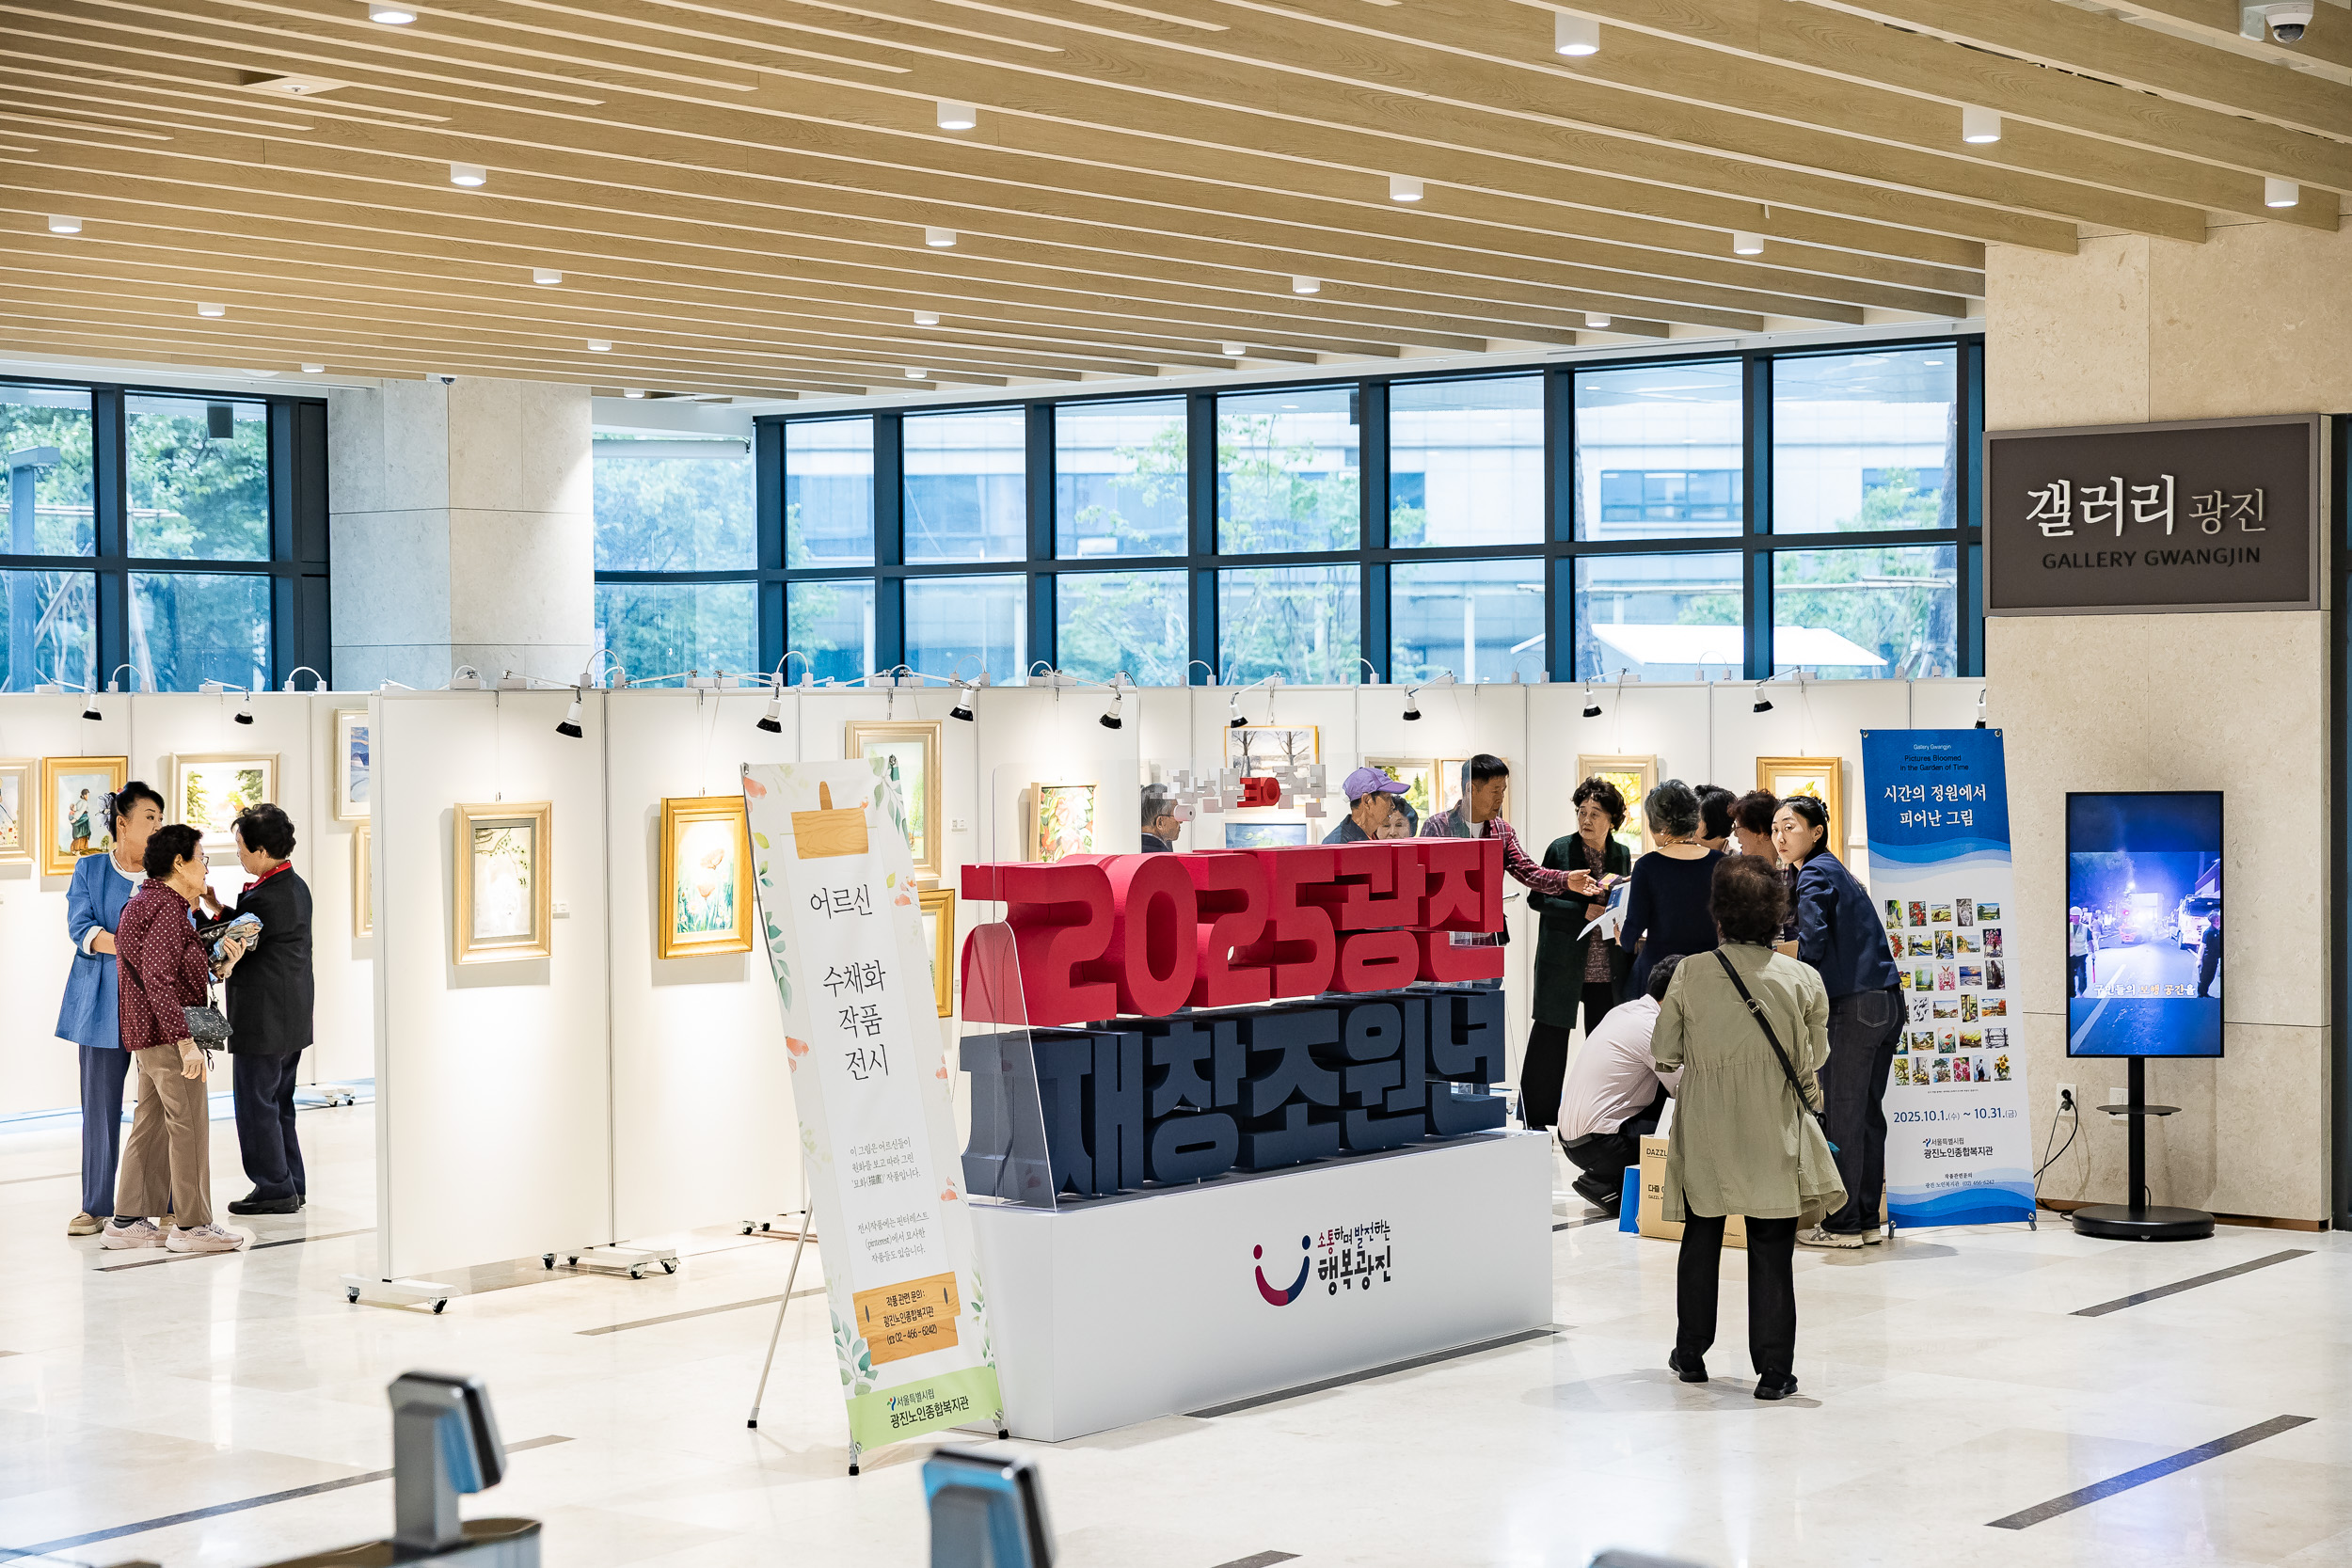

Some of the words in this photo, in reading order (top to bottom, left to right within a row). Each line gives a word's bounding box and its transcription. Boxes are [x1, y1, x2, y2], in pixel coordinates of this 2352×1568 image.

[2026, 473, 2174, 537] 갤러리
[2188, 487, 2266, 535] 광진
[2042, 550, 2137, 570] GALLERY
[2144, 546, 2261, 568] GWANGJIN
[1883, 784, 1926, 803] 시간의
[1931, 784, 1987, 802] 정원에서
[1899, 809, 1942, 828] 피어난
[1946, 808, 1974, 828] 그림
[809, 883, 873, 921] 어르신
[822, 959, 886, 999] 수채화
[2138, 984, 2160, 996] 보행
[2164, 984, 2197, 996] 공간을
[839, 1004, 883, 1039] 작품
[844, 1043, 890, 1081] 전시
[850, 1146, 857, 1156] 이
[858, 1143, 878, 1155] 그림은
[879, 1136, 911, 1151] 어르신들이
[1931, 1137, 1964, 1146] 서울특별시립
[873, 1158, 886, 1169] 보고
[886, 1154, 900, 1166] 따라
[901, 1151, 914, 1164] 그린
[1924, 1146, 1994, 1160] 광진노인종합복지관
[896, 1212, 930, 1226] 핀터레스트
[906, 1227, 926, 1241] 묘사한
[1317, 1226, 1353, 1255] 소통하며
[1354, 1219, 1391, 1249] 발전하는
[1317, 1245, 1391, 1295] 행복광진
[886, 1294, 898, 1307] 작품
[898, 1291, 911, 1306] 관련
[883, 1306, 934, 1328] 광진노인종합복지관
[897, 1387, 935, 1407] 서울특별시립
[890, 1395, 970, 1429] 광진노인종합복지관
